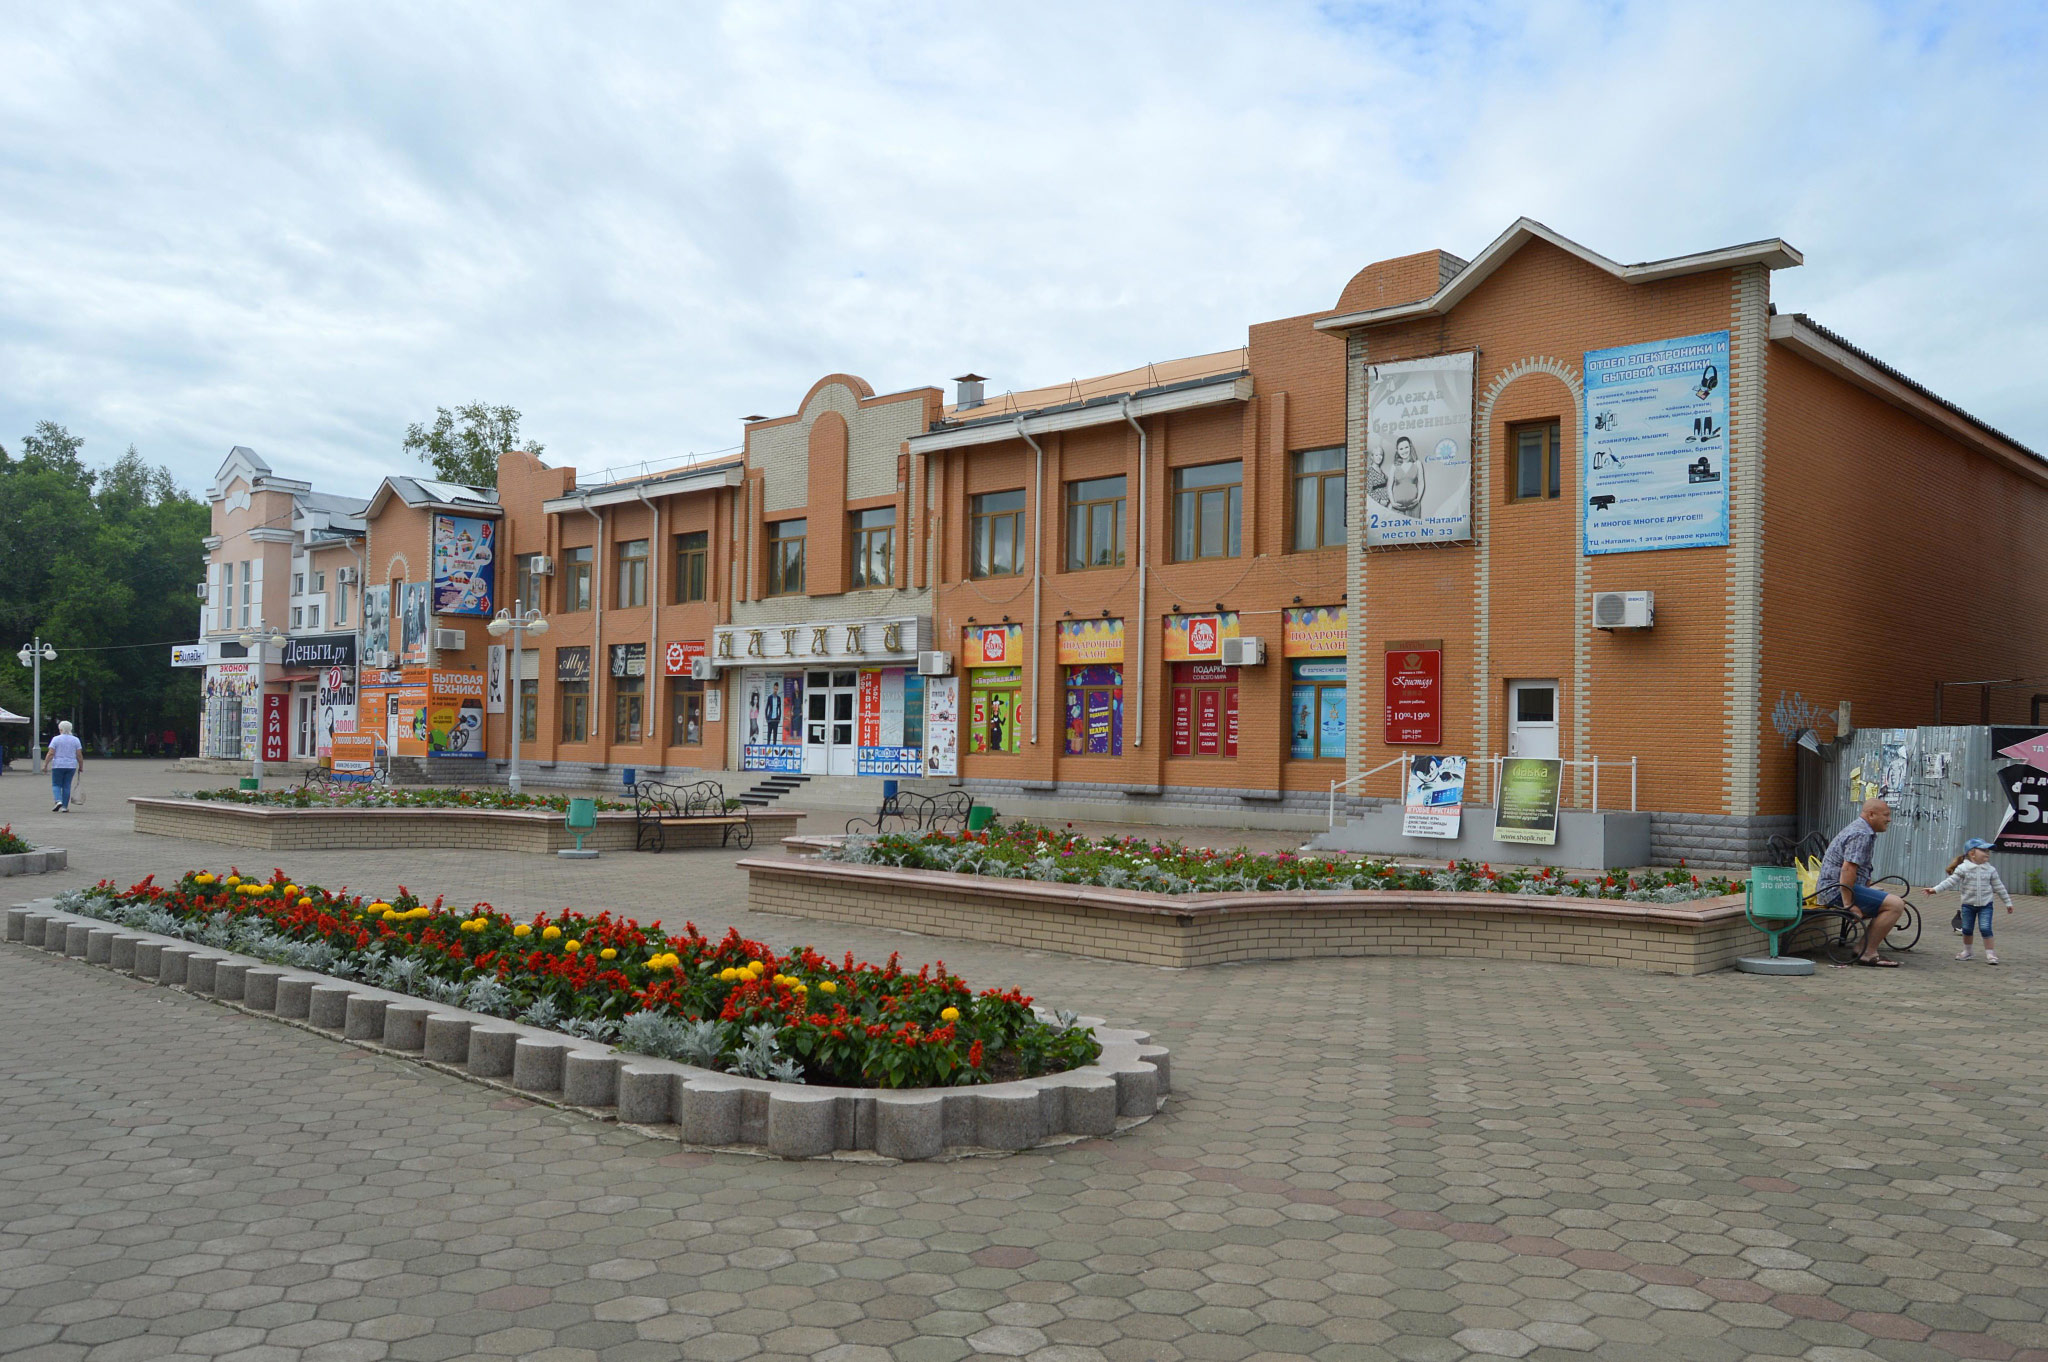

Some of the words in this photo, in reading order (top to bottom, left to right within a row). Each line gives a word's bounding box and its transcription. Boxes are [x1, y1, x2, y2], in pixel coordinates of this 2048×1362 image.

[1589, 357, 1625, 371] ОТДЕЛ
[1628, 344, 1713, 366] ЭЛЕКТРОНИКИ
[1716, 342, 1726, 353] И
[1602, 364, 1655, 383] БЫТОВОЙ
[1658, 359, 1711, 375] ТЕХНИКИ
[1387, 391, 1444, 406] одежда
[1401, 405, 1429, 418] для
[1372, 414, 1467, 434] беременных
[1370, 514, 1379, 528] 2
[1380, 519, 1412, 528] этаж
[1600, 520, 1632, 528] МНОГОЕ
[1633, 517, 1665, 525] МНОГОЕ
[1666, 514, 1704, 523] ДРУГОЕ!!!
[1382, 530, 1417, 539] место
[1421, 528, 1434, 537] №
[1600, 538, 1637, 546] «Натали»,
[1645, 535, 1663, 543] этаж
[1664, 533, 1694, 542] (правое
[1063, 639, 1122, 650] ПОДАРОЧНЫЙ
[1310, 641, 1346, 651] САЛОН
[286, 640, 348, 667] Деньги.ру
[220, 664, 248, 672] ЭКОНОМ
[432, 673, 483, 685] БЫТОВАЯ
[432, 683, 482, 695] ТЕХНИКА
[864, 673, 872, 747] ЛИКВИДАЦИЯ
[974, 704, 985, 723] 5
[267, 696, 282, 759] ЗАЙМЫ
